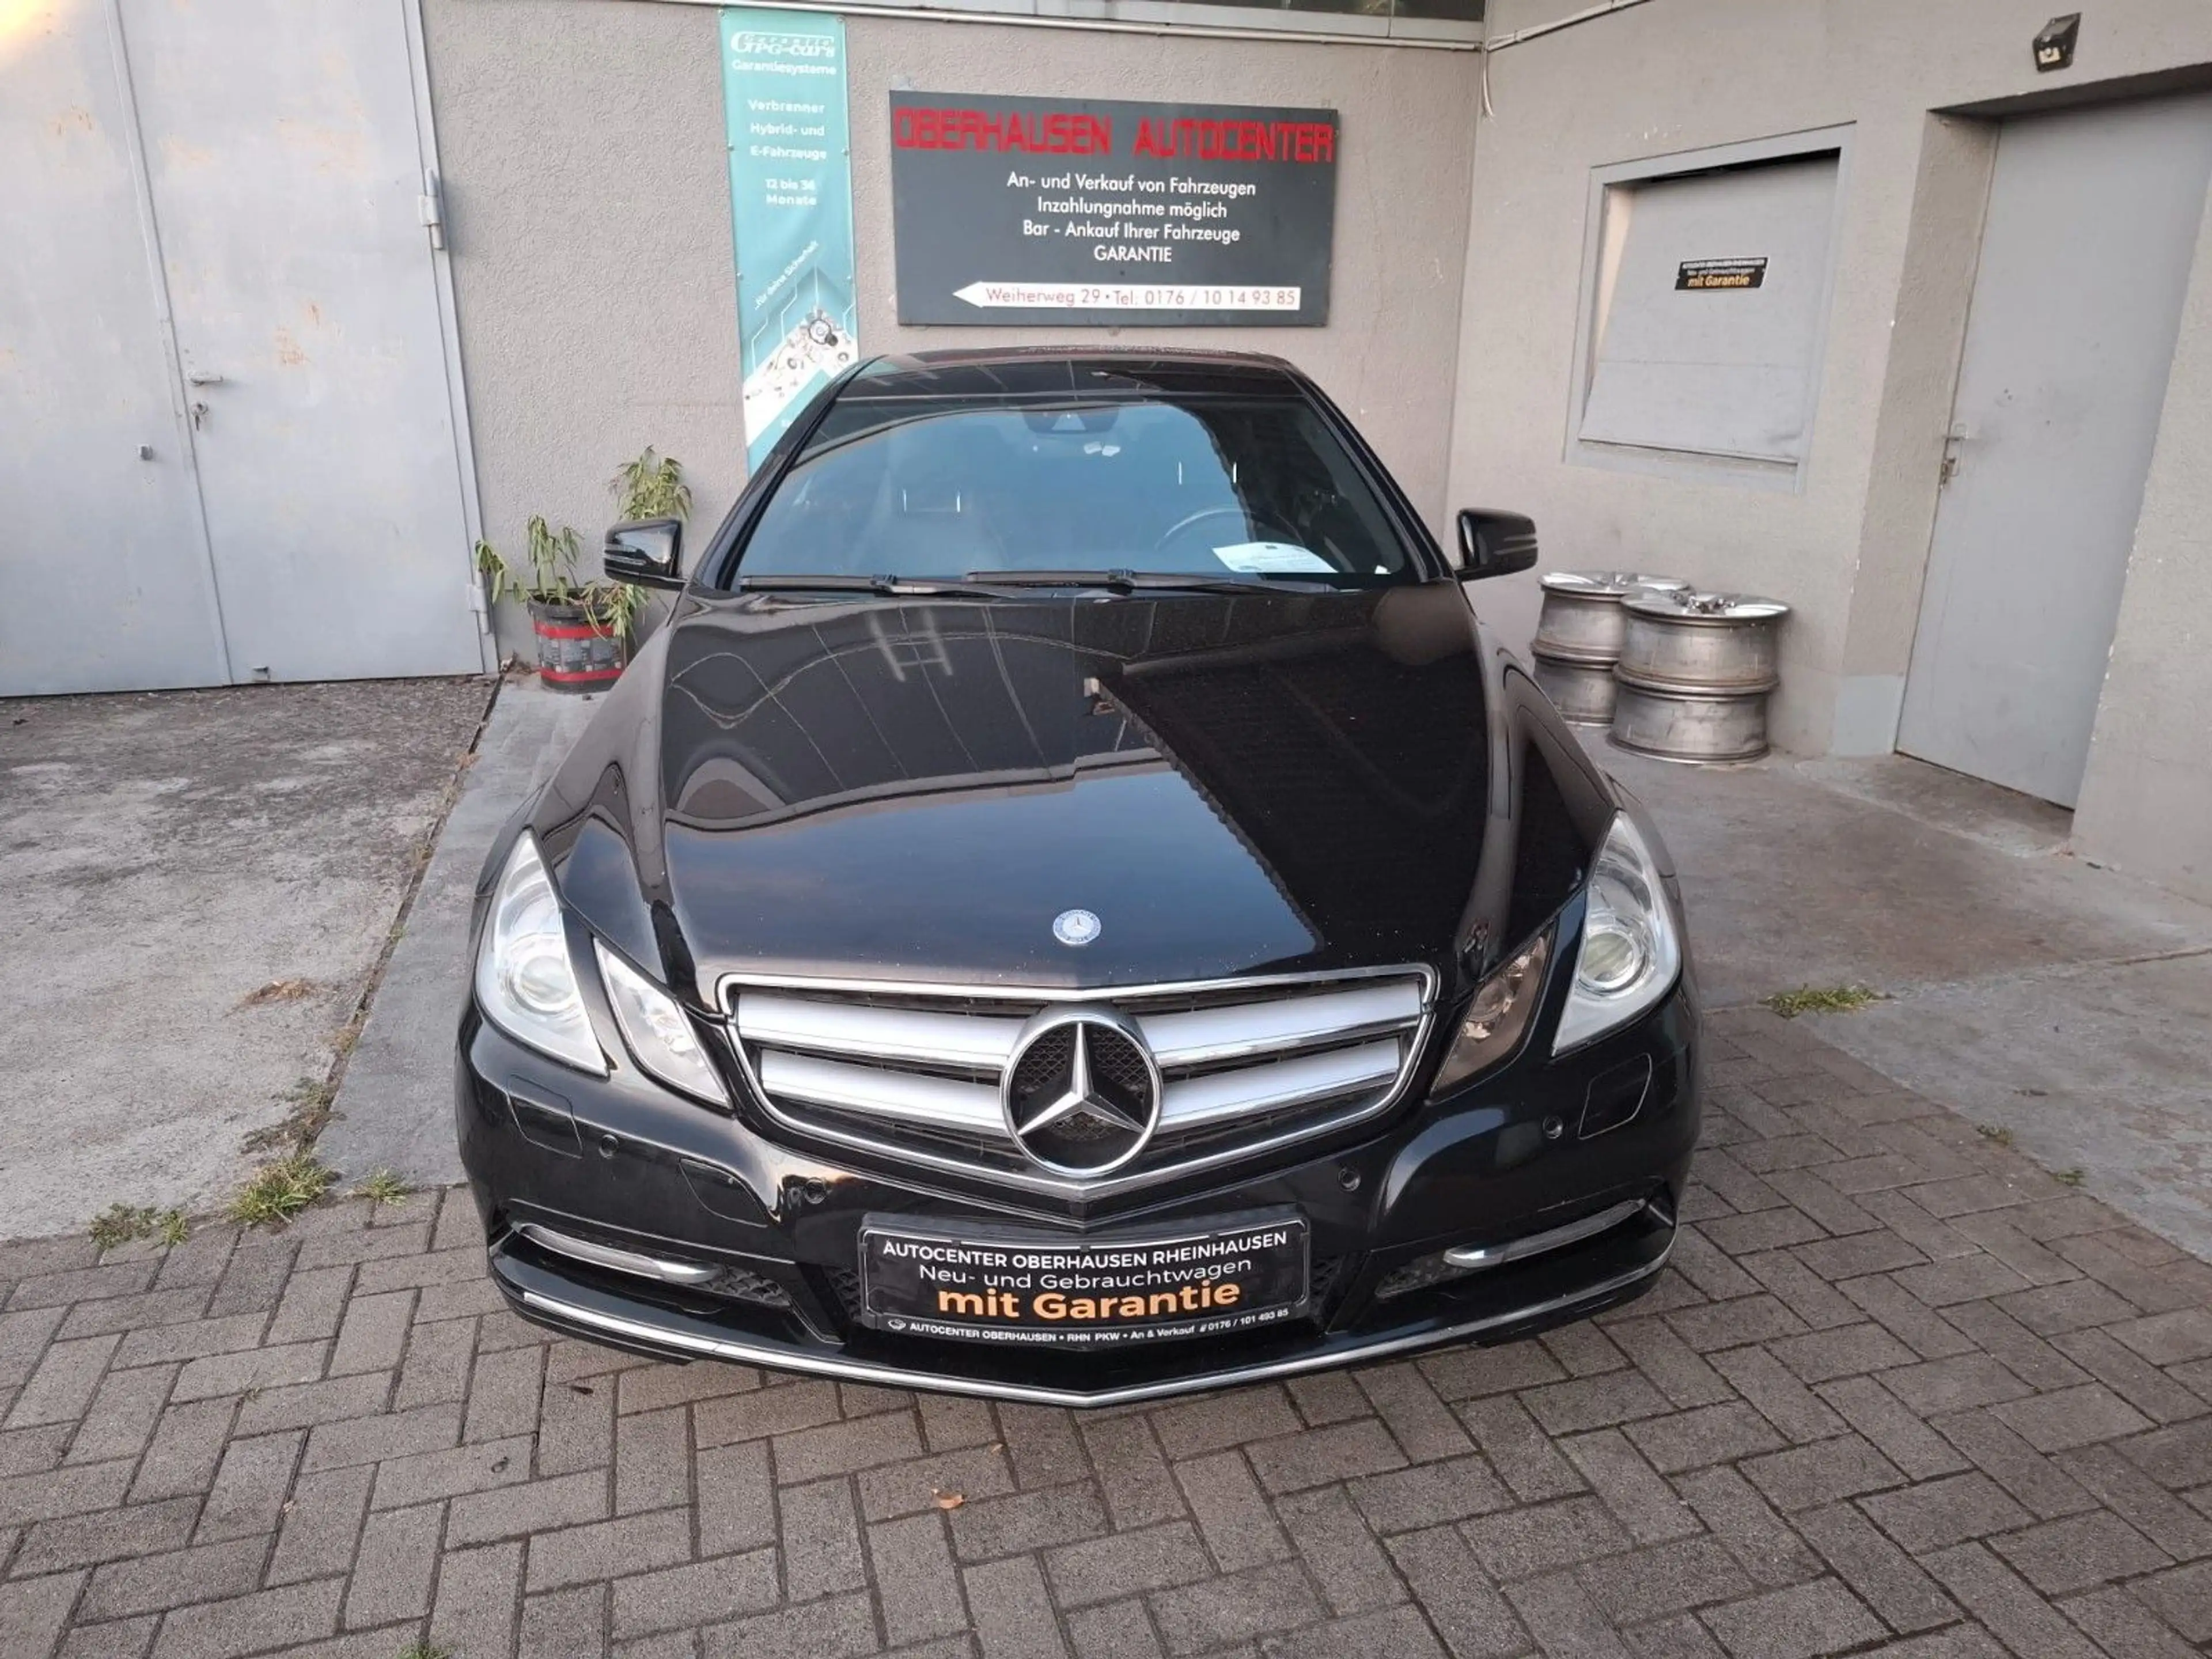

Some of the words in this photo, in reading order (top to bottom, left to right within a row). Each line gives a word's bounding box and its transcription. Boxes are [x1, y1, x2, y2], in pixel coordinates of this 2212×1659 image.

[732, 59, 837, 76] Garantiesysteme
[747, 100, 825, 114] Verbrenner
[750, 122, 797, 135] Hybrid-
[801, 126, 825, 136] und
[895, 106, 1112, 156] OBERHAUSEN
[1132, 116, 1334, 162] AUTOCENTER
[751, 145, 827, 161] E-Fahrzeuge
[765, 179, 778, 190] 12
[781, 179, 799, 190] bis
[1007, 172, 1036, 188] An-
[1041, 173, 1070, 189] und
[1074, 174, 1134, 192] Verkauf
[1138, 180, 1165, 193] von
[1170, 177, 1256, 199] Fahrzeugen
[766, 194, 817, 206] Monate
[1037, 196, 1165, 219] Inzahlungnahme
[1169, 202, 1227, 221] möglich
[1023, 219, 1050, 236] Bar
[1065, 222, 1119, 238] Ankauf
[1124, 224, 1160, 239] Ihrer
[1164, 225, 1240, 245] Fahrzeuge
[1094, 245, 1172, 263] GARANTIE
[1688, 277, 1703, 287] mit
[1705, 275, 1749, 286] Garantie
[986, 287, 1075, 308] Weiherweg
[1081, 289, 1101, 302] 29
[1145, 290, 1185, 305] 0176
[1189, 290, 1196, 305] /
[1205, 290, 1222, 305] 10
[1229, 291, 1246, 305] 14
[1252, 291, 1270, 306] 93
[1277, 292, 1296, 306] 85
[882, 1240, 1007, 1267] AUTOCENTER
[1012, 1252, 1147, 1270] OBERHAUSEN
[1153, 1231, 1287, 1266] RHEINHAUSEN
[919, 1264, 976, 1285] Neu-
[984, 1273, 1031, 1289] und
[1040, 1259, 1252, 1290] Gebrauchtwagen
[938, 1288, 1020, 1319] mit
[1033, 1279, 1241, 1319] Garantie
[910, 1322, 979, 1338] AUTOCENTER
[983, 1330, 1056, 1342] OBERHAUSEN
[1067, 1333, 1090, 1342] RHN
[1094, 1332, 1120, 1341] PKW
[1130, 1331, 1145, 1340] An
[1147, 1330, 1154, 1338] &
[1157, 1325, 1195, 1338] Verkauf
[1240, 1315, 1256, 1325] 101
[1277, 1308, 1289, 1317] 85
